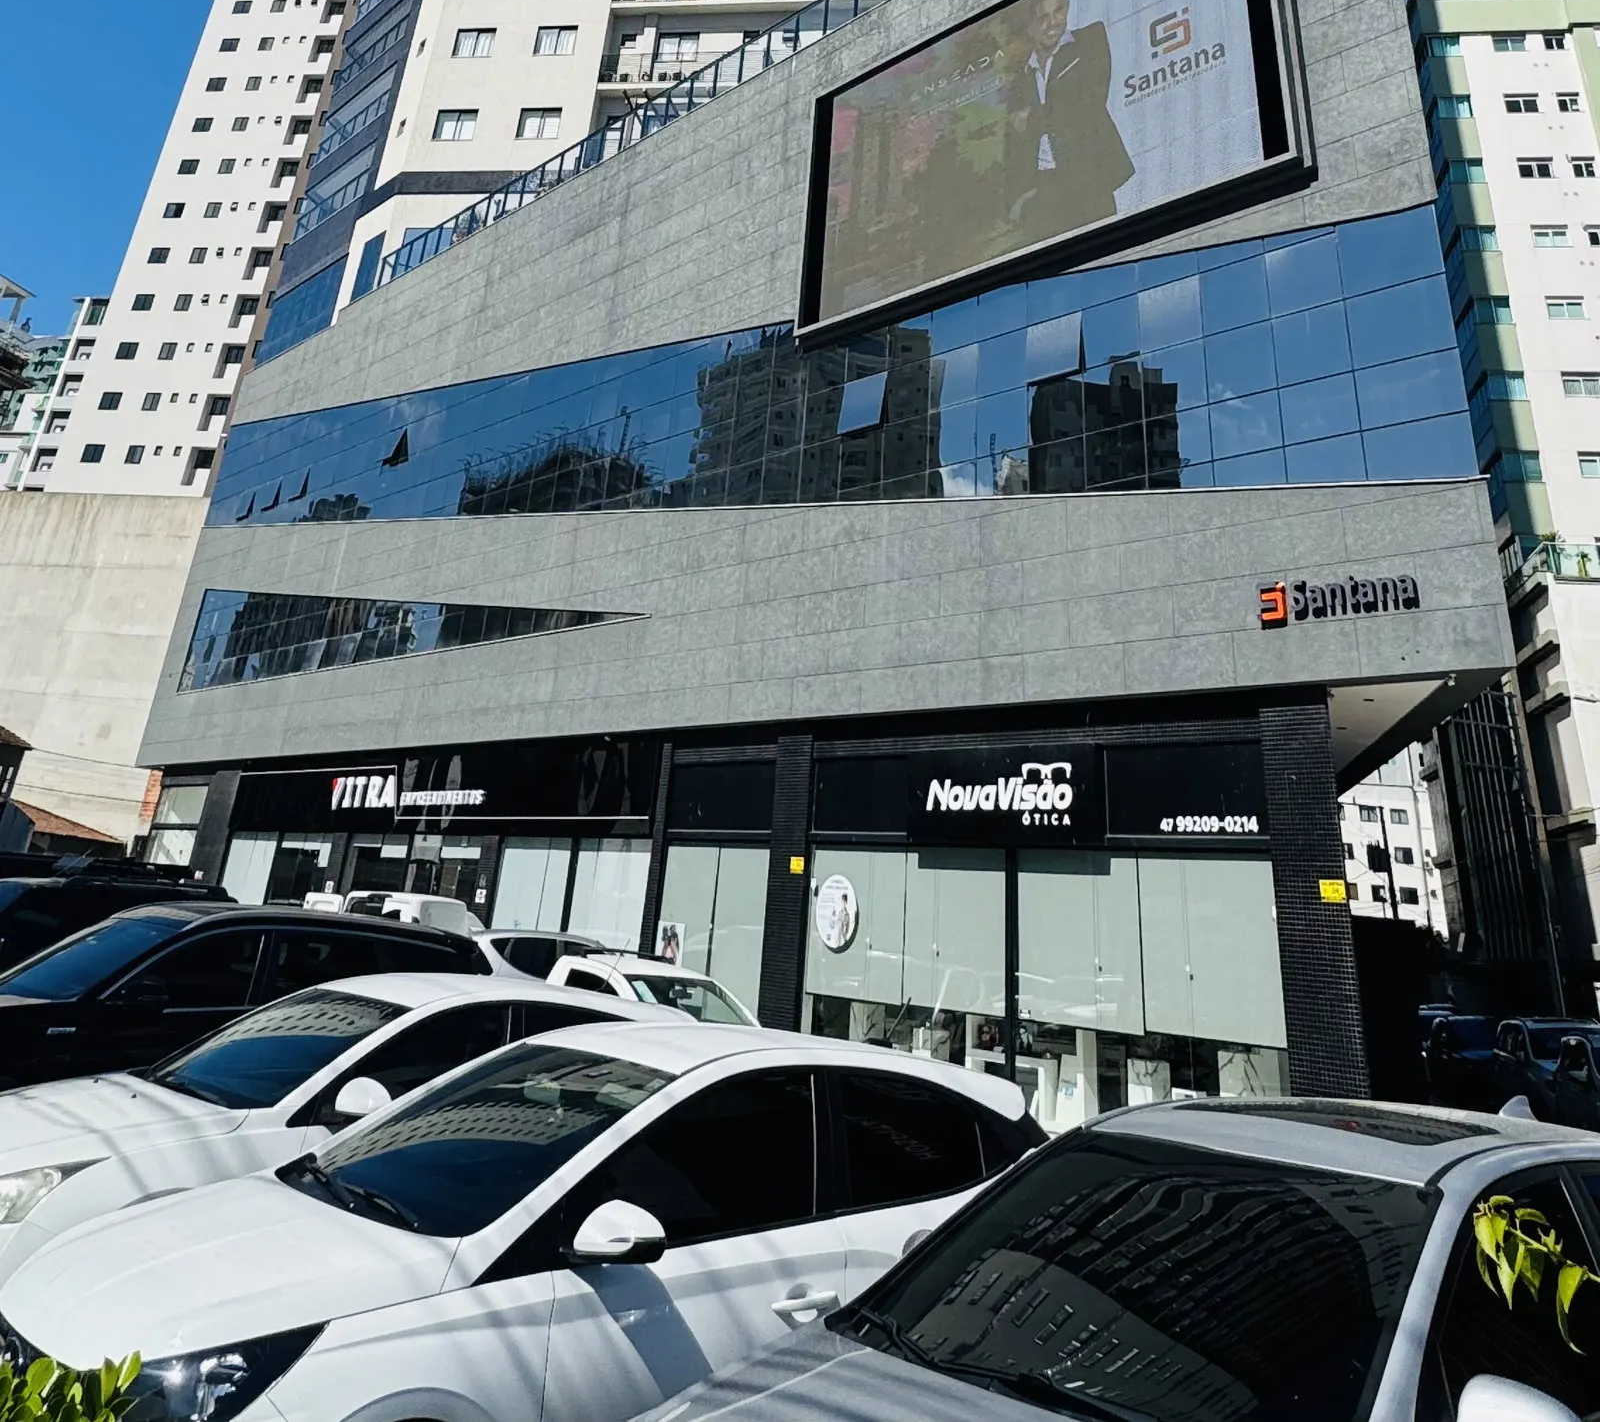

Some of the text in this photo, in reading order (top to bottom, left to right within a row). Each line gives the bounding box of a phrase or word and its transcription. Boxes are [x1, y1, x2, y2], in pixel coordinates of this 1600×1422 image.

[1124, 43, 1226, 99] Santana
[1289, 575, 1420, 620] Santana
[331, 775, 395, 810] VITRA
[1022, 810, 1071, 826] ÓTICA
[1160, 815, 1259, 833] 47 99209-0214
